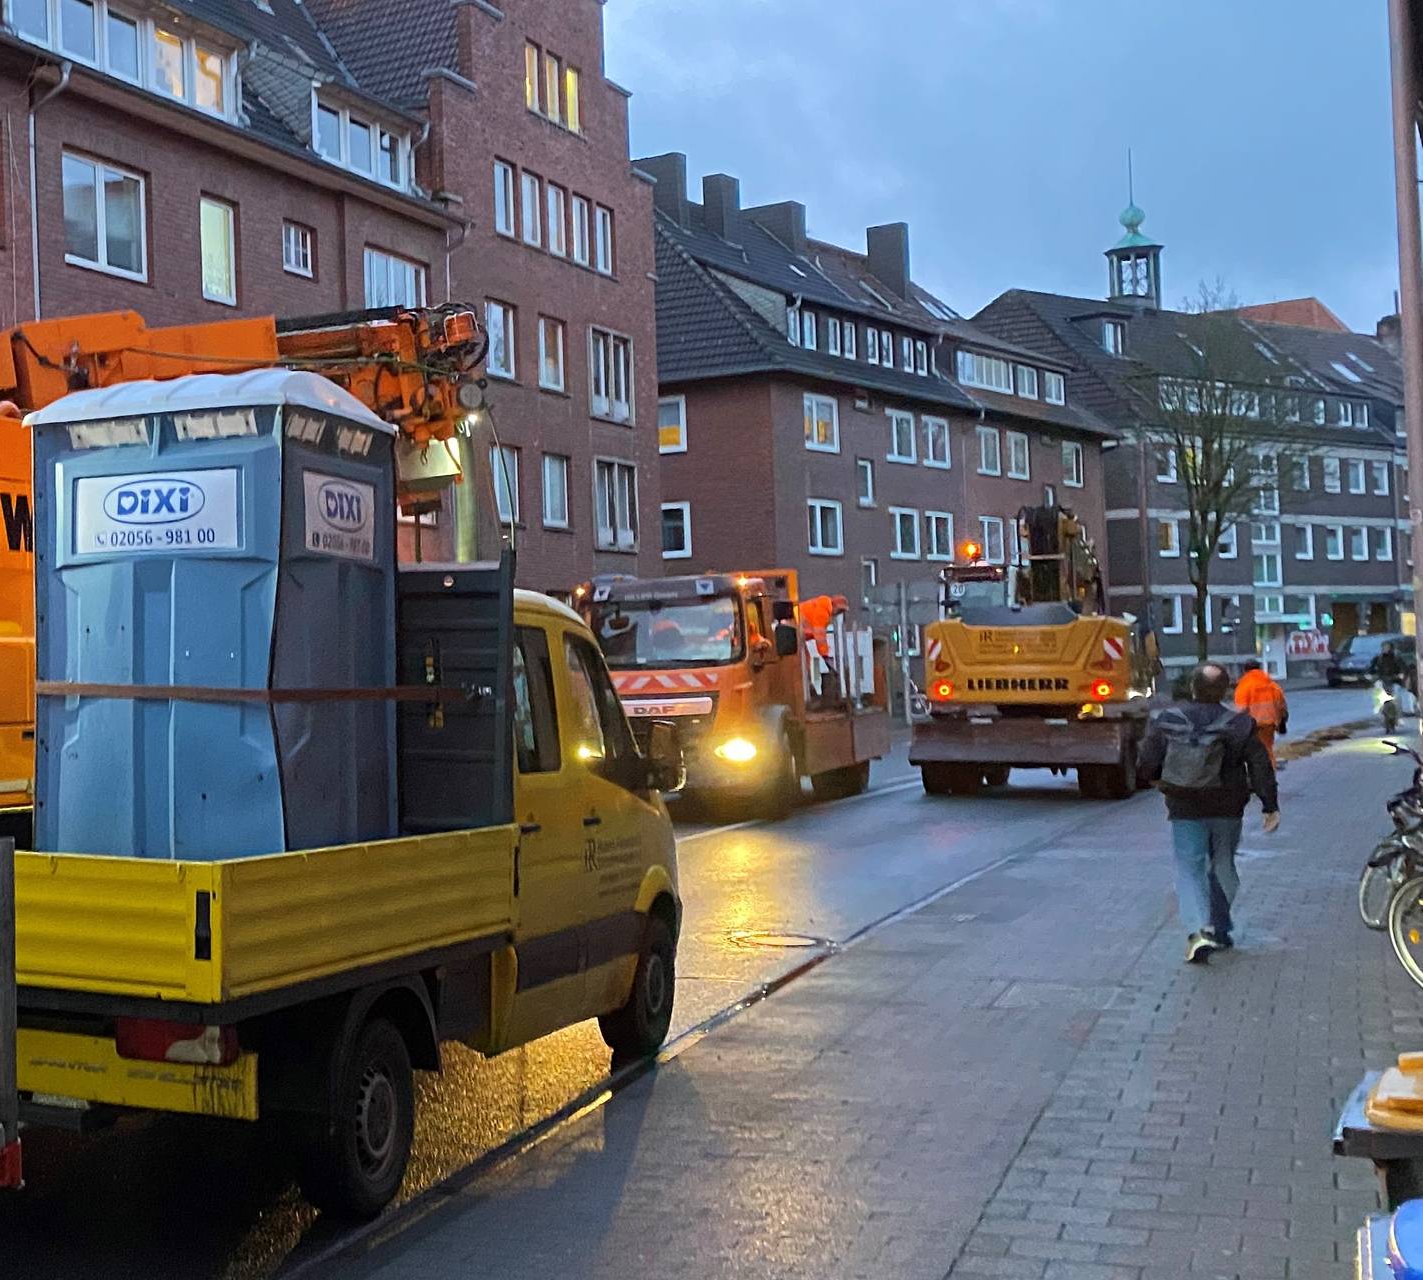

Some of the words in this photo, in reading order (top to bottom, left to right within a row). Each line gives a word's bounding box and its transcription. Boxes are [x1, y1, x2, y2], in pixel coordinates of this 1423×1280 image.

[110, 530, 153, 547] 02056
[165, 528, 192, 545] 981
[197, 527, 216, 543] 00
[967, 678, 1069, 691] LIEBHERR
[634, 706, 675, 715] DAF
